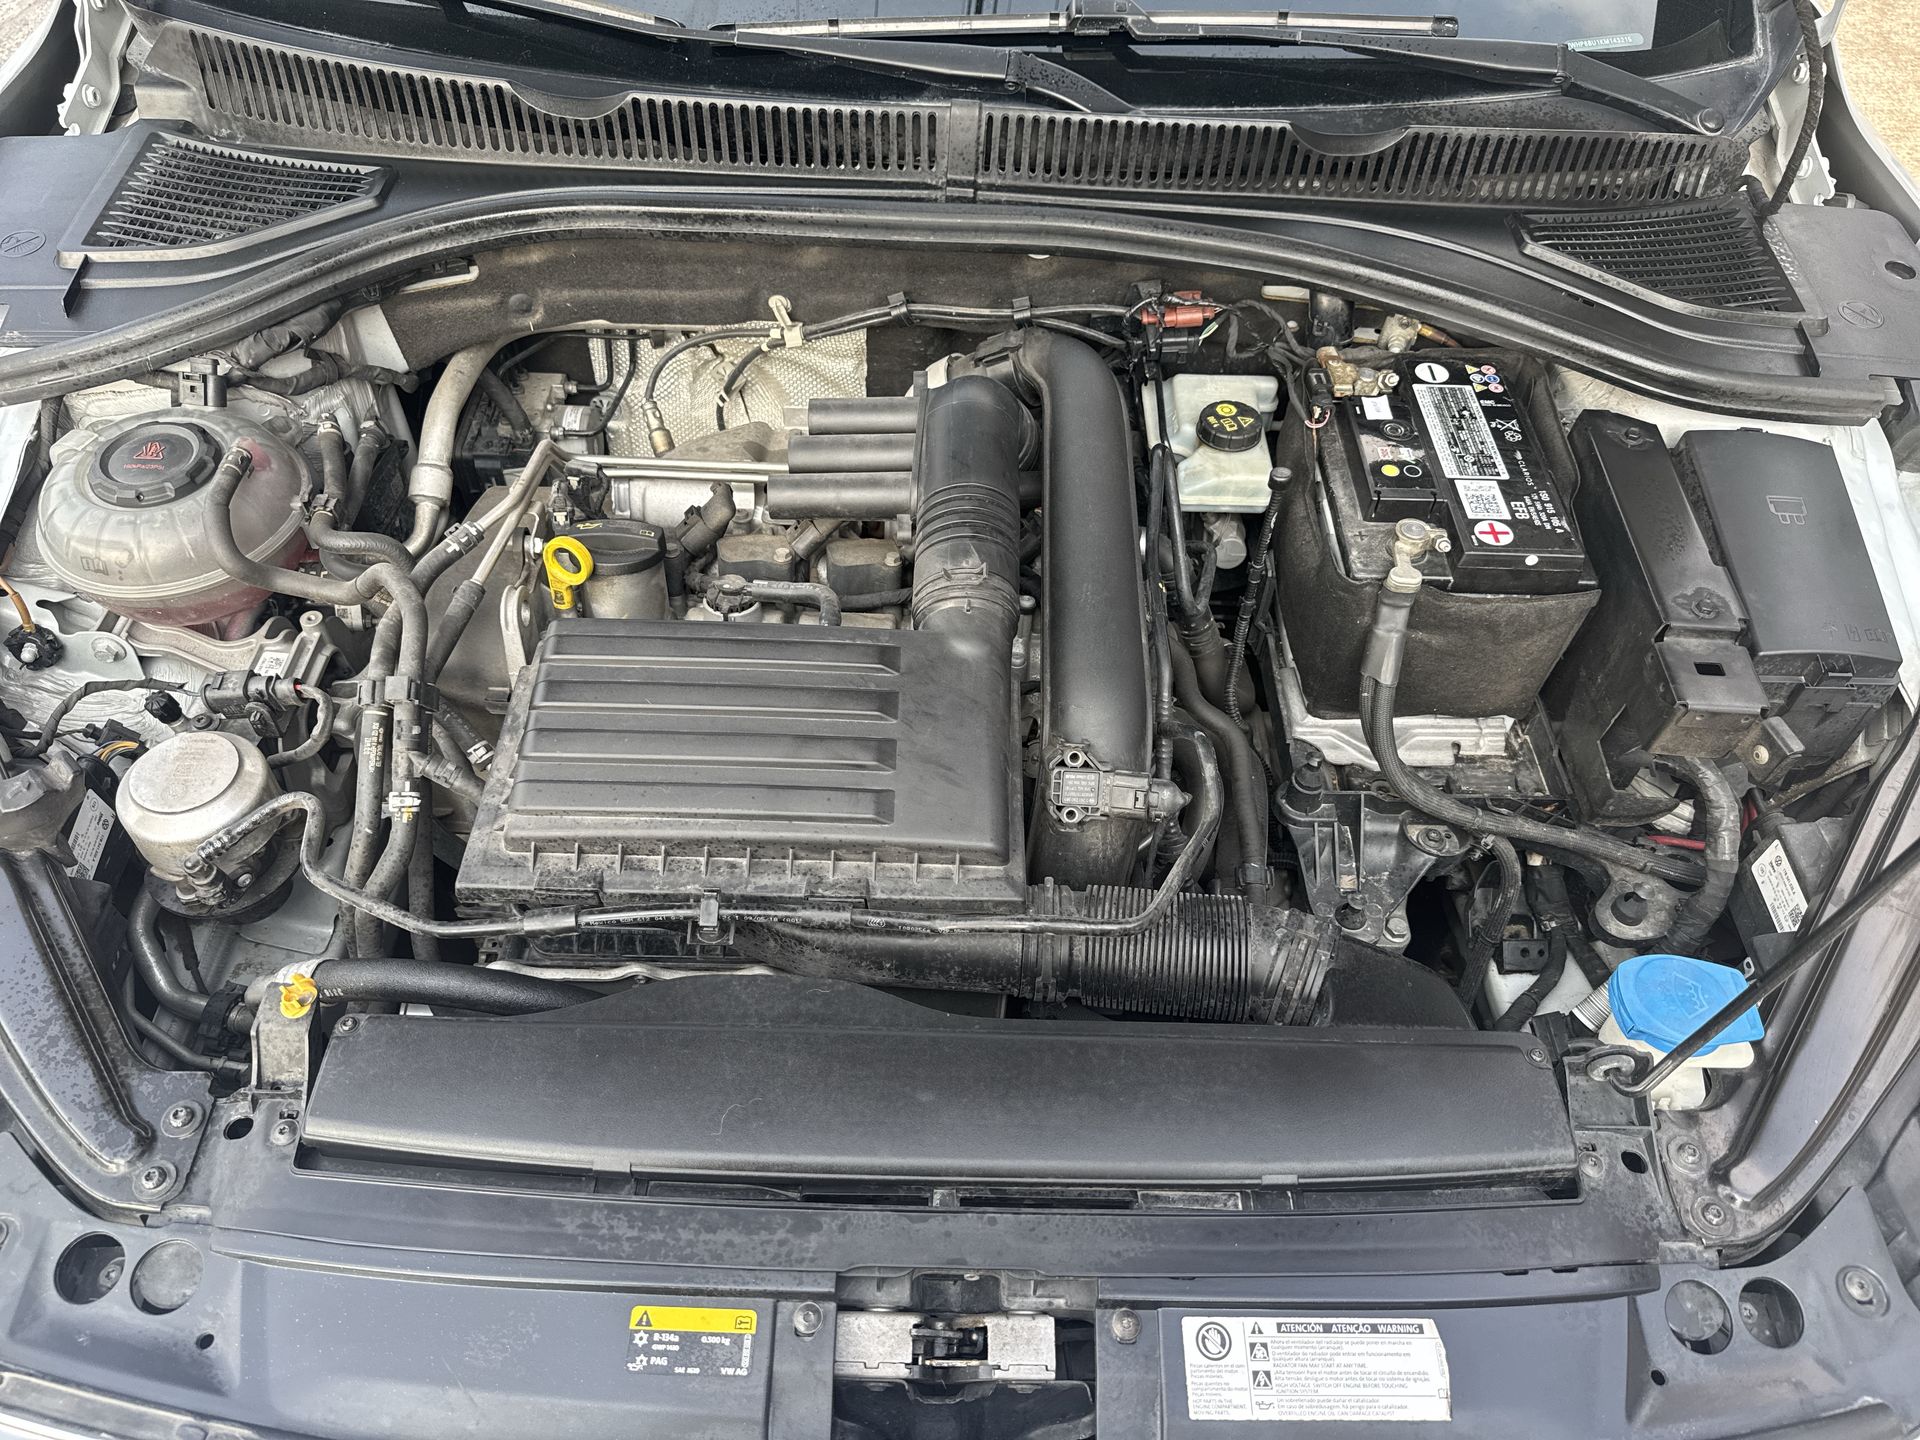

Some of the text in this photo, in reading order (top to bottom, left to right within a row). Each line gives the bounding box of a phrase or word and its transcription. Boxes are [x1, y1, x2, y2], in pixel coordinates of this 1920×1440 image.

[1518, 460, 1534, 486] CLARIOS
[1510, 501, 1530, 520] EFB
[1544, 503, 1555, 514] 915
[1281, 1322, 1419, 1334] ATENCIÓN ATENÇÃO WARNING
[653, 1333, 680, 1342] R-134a
[721, 1336, 730, 1346] kg
[650, 1356, 668, 1365] PAG
[735, 1368, 748, 1376] AG
